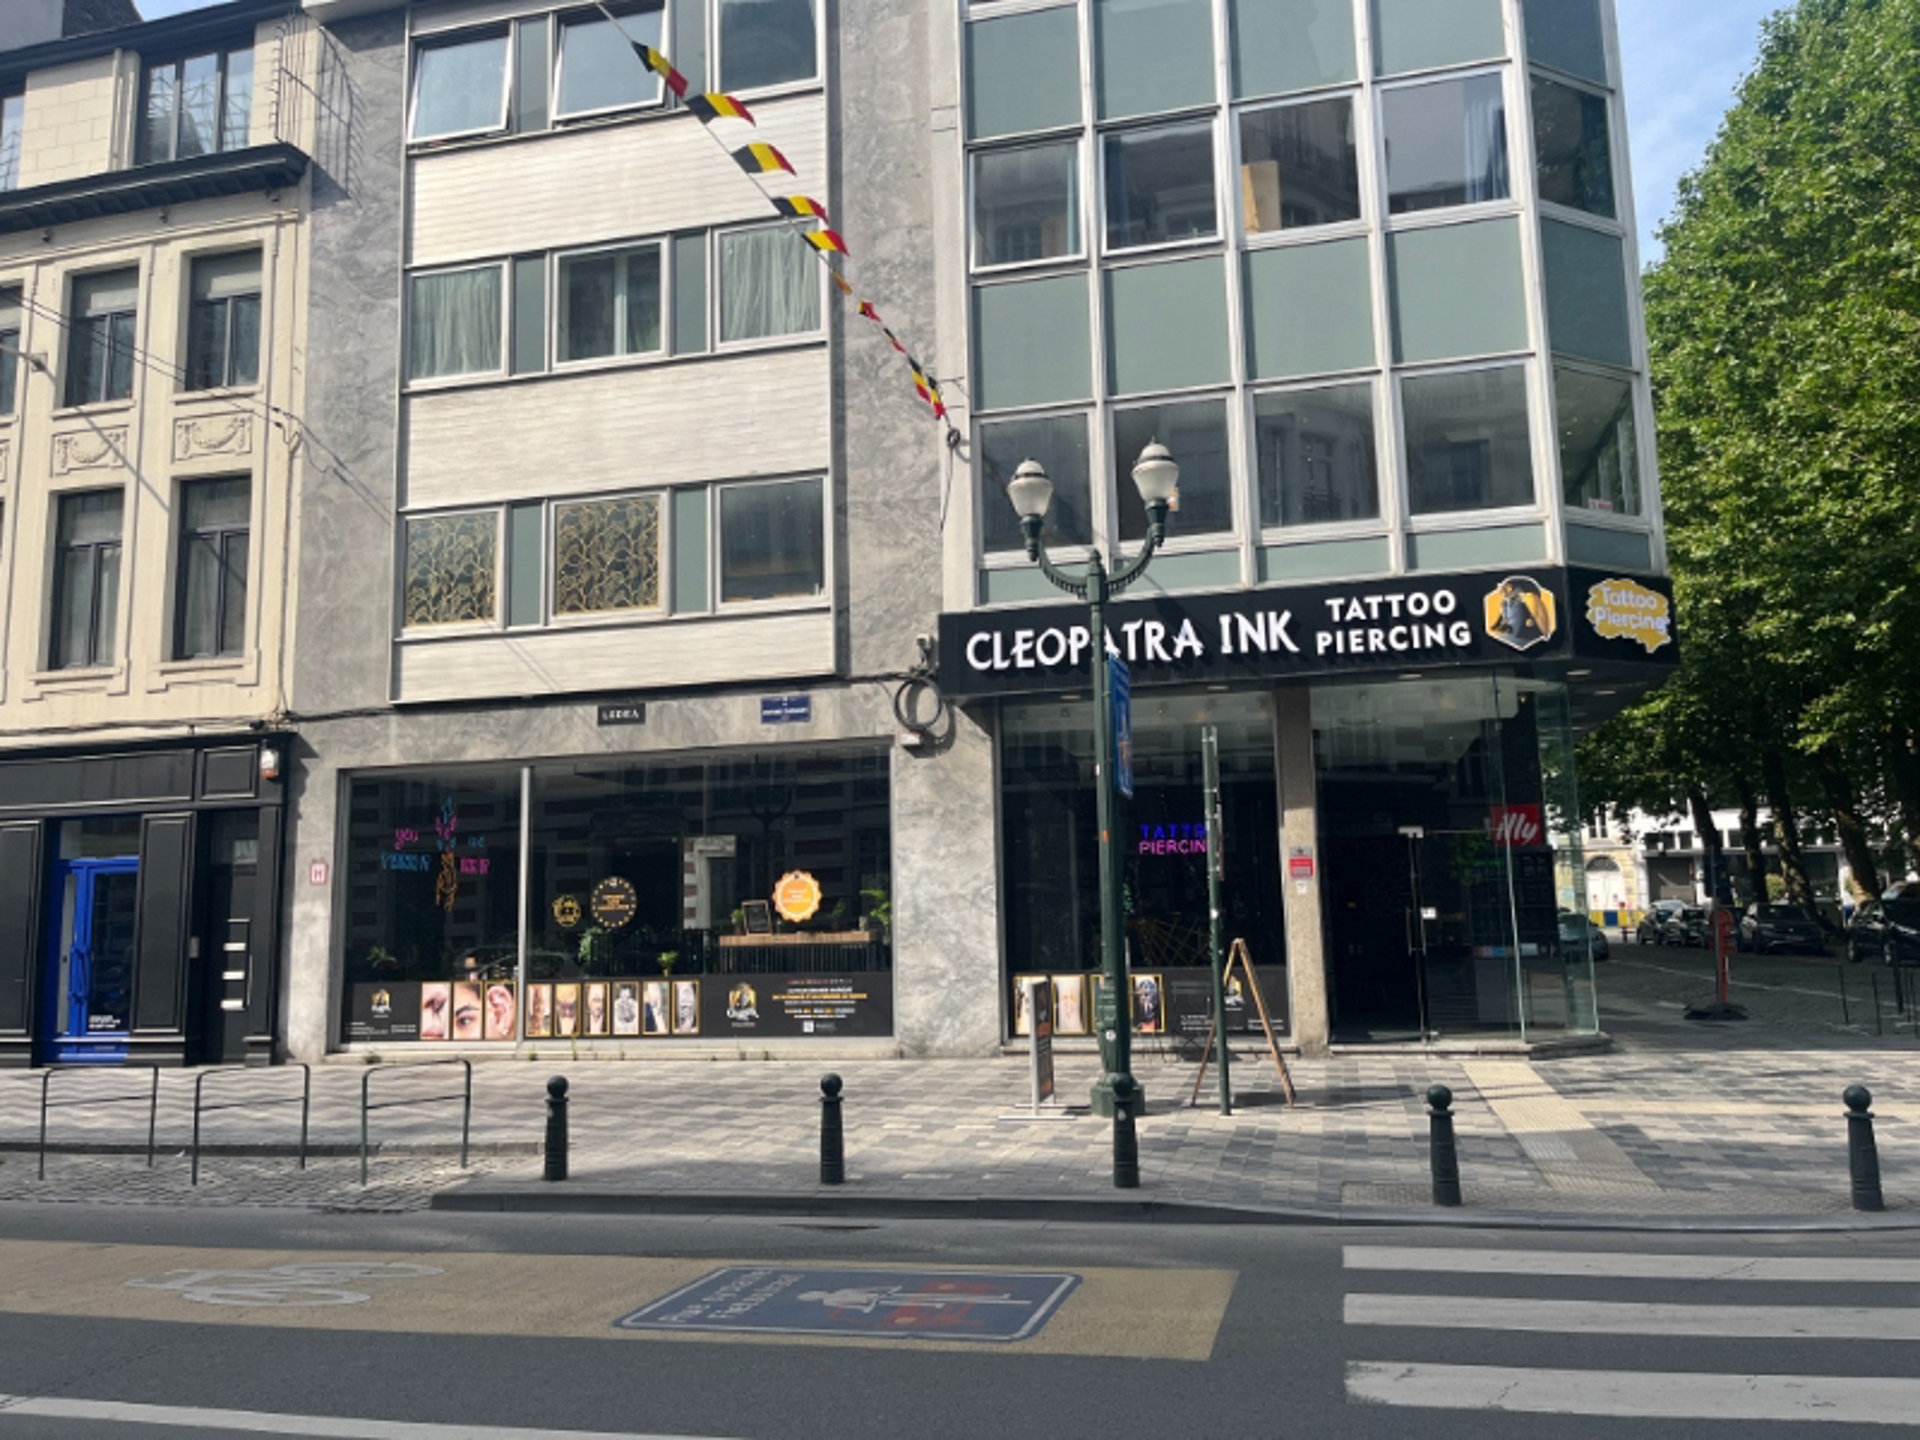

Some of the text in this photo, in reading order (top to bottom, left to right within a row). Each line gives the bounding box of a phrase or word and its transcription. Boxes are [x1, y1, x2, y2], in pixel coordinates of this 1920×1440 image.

[1324, 589, 1457, 623] TATTOO
[1601, 585, 1657, 610] Tattoo
[1594, 606, 1671, 634] Piercing
[965, 609, 1300, 670] CLEOPATRA INK
[1315, 620, 1472, 656] PIERCING
[1140, 823, 1205, 839] TATTO
[1138, 839, 1207, 856] PIERCIN
